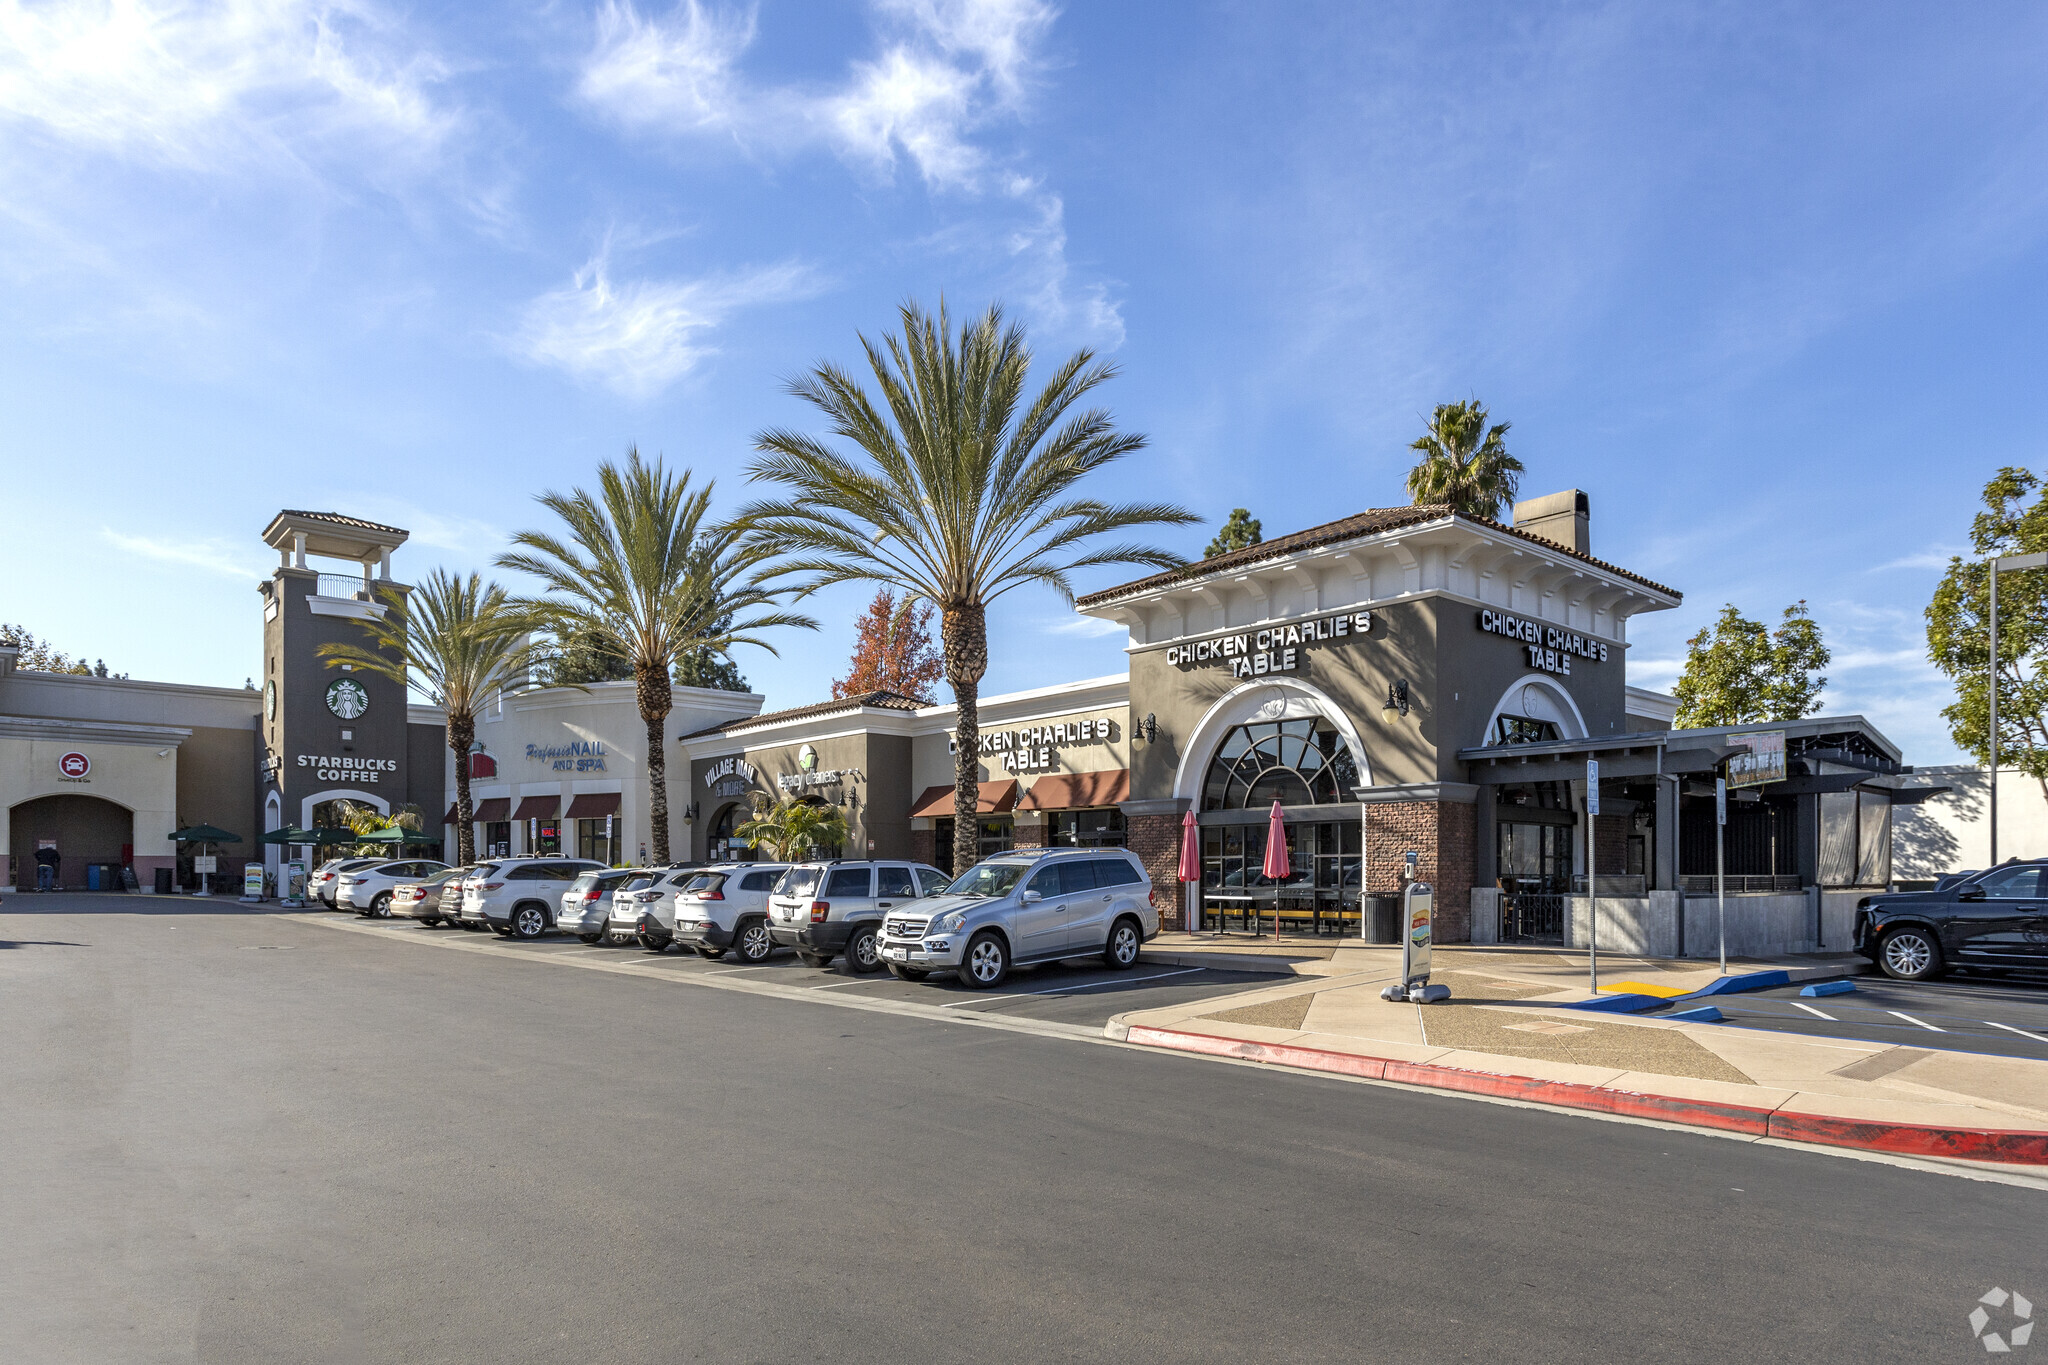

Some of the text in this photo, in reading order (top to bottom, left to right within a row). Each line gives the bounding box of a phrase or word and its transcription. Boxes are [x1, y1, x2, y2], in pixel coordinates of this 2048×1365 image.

[1166, 611, 1371, 666] CHICKEN CHARLIE'S
[1482, 609, 1608, 662] CHICKEN CHARLIE'S
[1229, 648, 1296, 678] TABLE
[1528, 645, 1571, 676] TABLE
[949, 718, 1109, 755] CKEN CHARLIE'S
[297, 754, 397, 772] STARBUCKS
[552, 759, 605, 772] AND SPA
[704, 757, 756, 788] VILLAGE MAIL
[999, 747, 1050, 771] TABLE
[317, 769, 379, 783] COFFEE
[716, 780, 745, 797] & MORE
[777, 769, 836, 792] legacy cleaners
